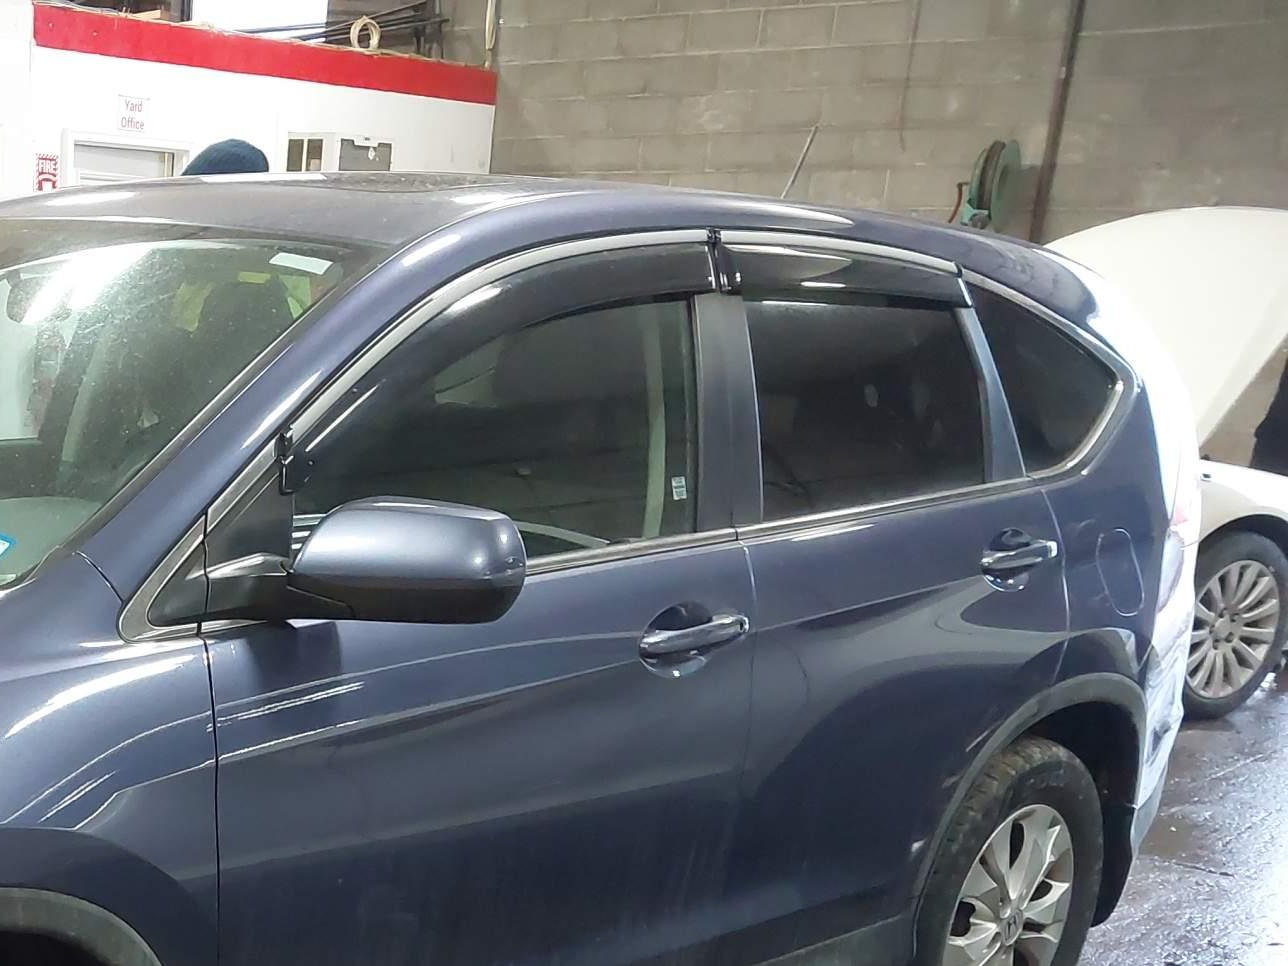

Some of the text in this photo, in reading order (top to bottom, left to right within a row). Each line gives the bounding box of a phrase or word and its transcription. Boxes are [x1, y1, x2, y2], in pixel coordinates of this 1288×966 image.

[125, 99, 142, 113] Yard
[121, 117, 144, 130] Office
[38, 159, 56, 174] FIRE
